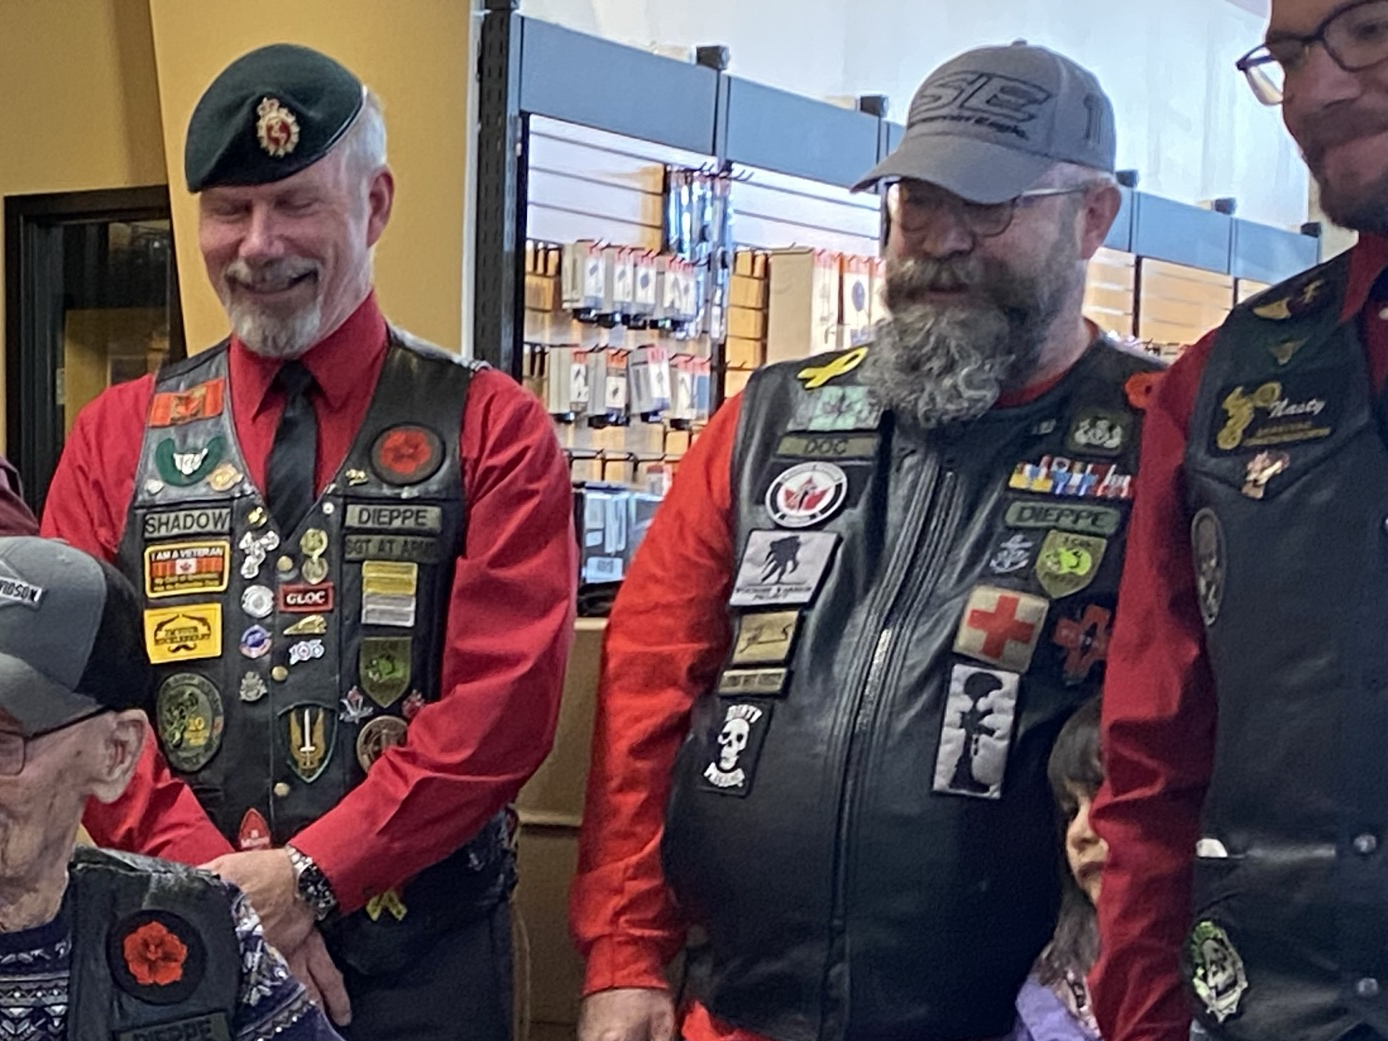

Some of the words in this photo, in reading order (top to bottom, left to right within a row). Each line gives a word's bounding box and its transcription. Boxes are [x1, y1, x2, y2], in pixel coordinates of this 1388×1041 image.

[805, 440, 848, 455] DOC
[358, 508, 428, 526] DIEPPE
[1016, 506, 1109, 524] DIEPPE
[145, 512, 229, 534] SHADOW
[180, 547, 224, 559] VETERAN
[378, 539, 395, 553] AT
[286, 591, 326, 605] GLOC
